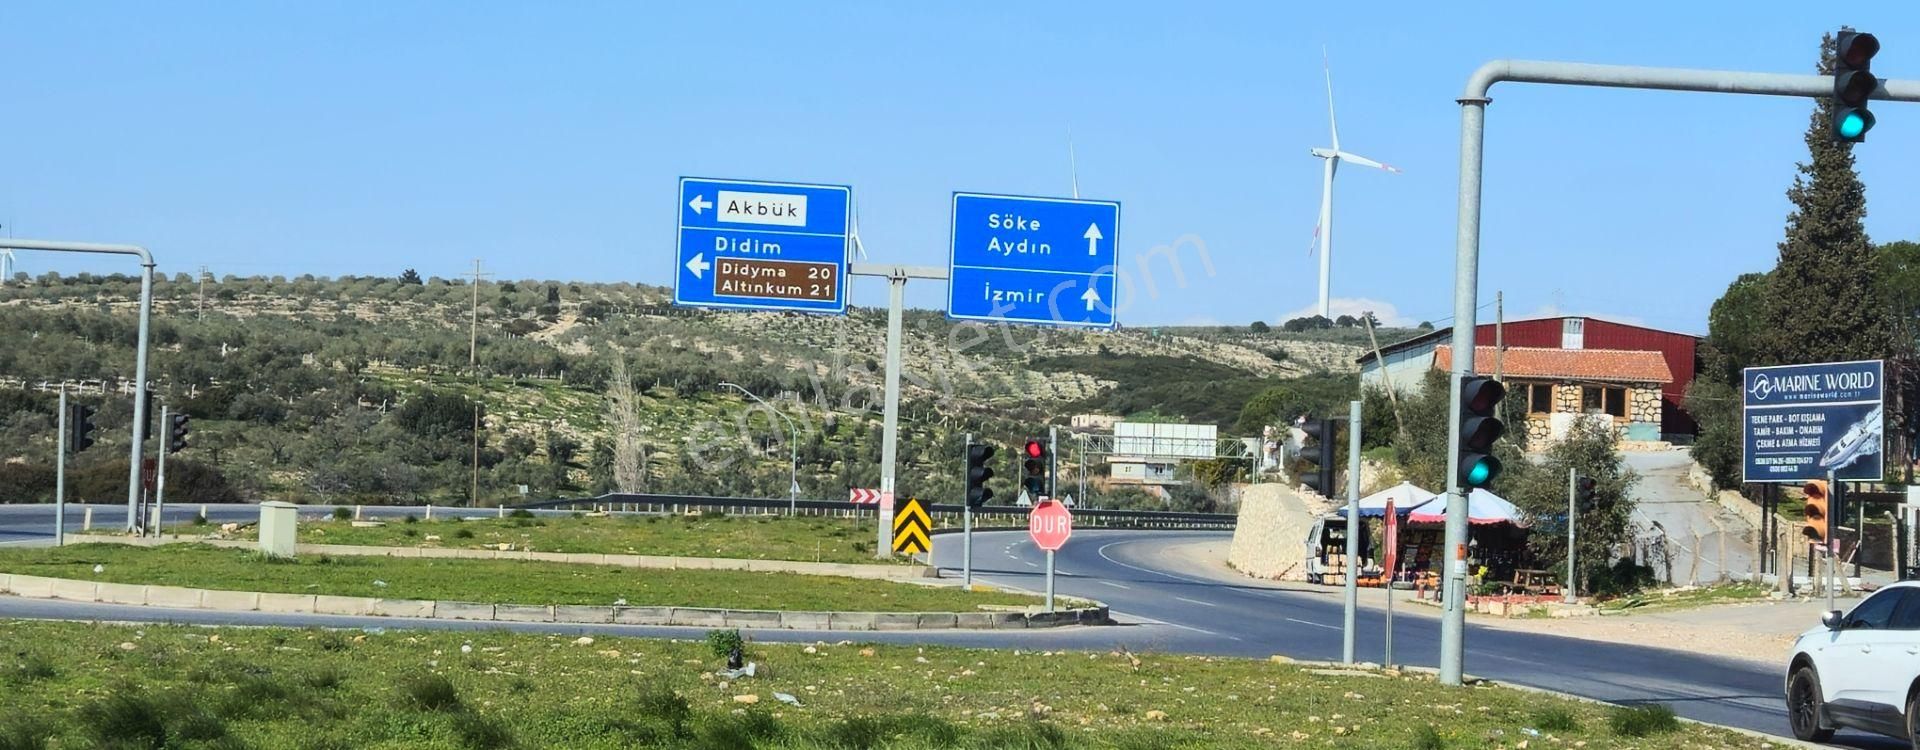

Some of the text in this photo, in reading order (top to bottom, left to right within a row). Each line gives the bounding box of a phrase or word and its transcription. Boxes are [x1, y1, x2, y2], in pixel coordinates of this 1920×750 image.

[727, 200, 798, 217] Akbük
[988, 213, 1041, 231] Söke
[715, 236, 781, 254] Didim
[987, 236, 1051, 256] Aydın
[722, 263, 831, 280] Didyma 20
[722, 279, 830, 296] Altınkum 21
[984, 282, 1045, 303] İzmir
[1774, 371, 1875, 392] MARINE WORLD
[1769, 414, 1783, 423] PARK
[1788, 413, 1800, 423] BOT
[1776, 426, 1794, 435] BAKIM
[1033, 515, 1067, 534] DUR
